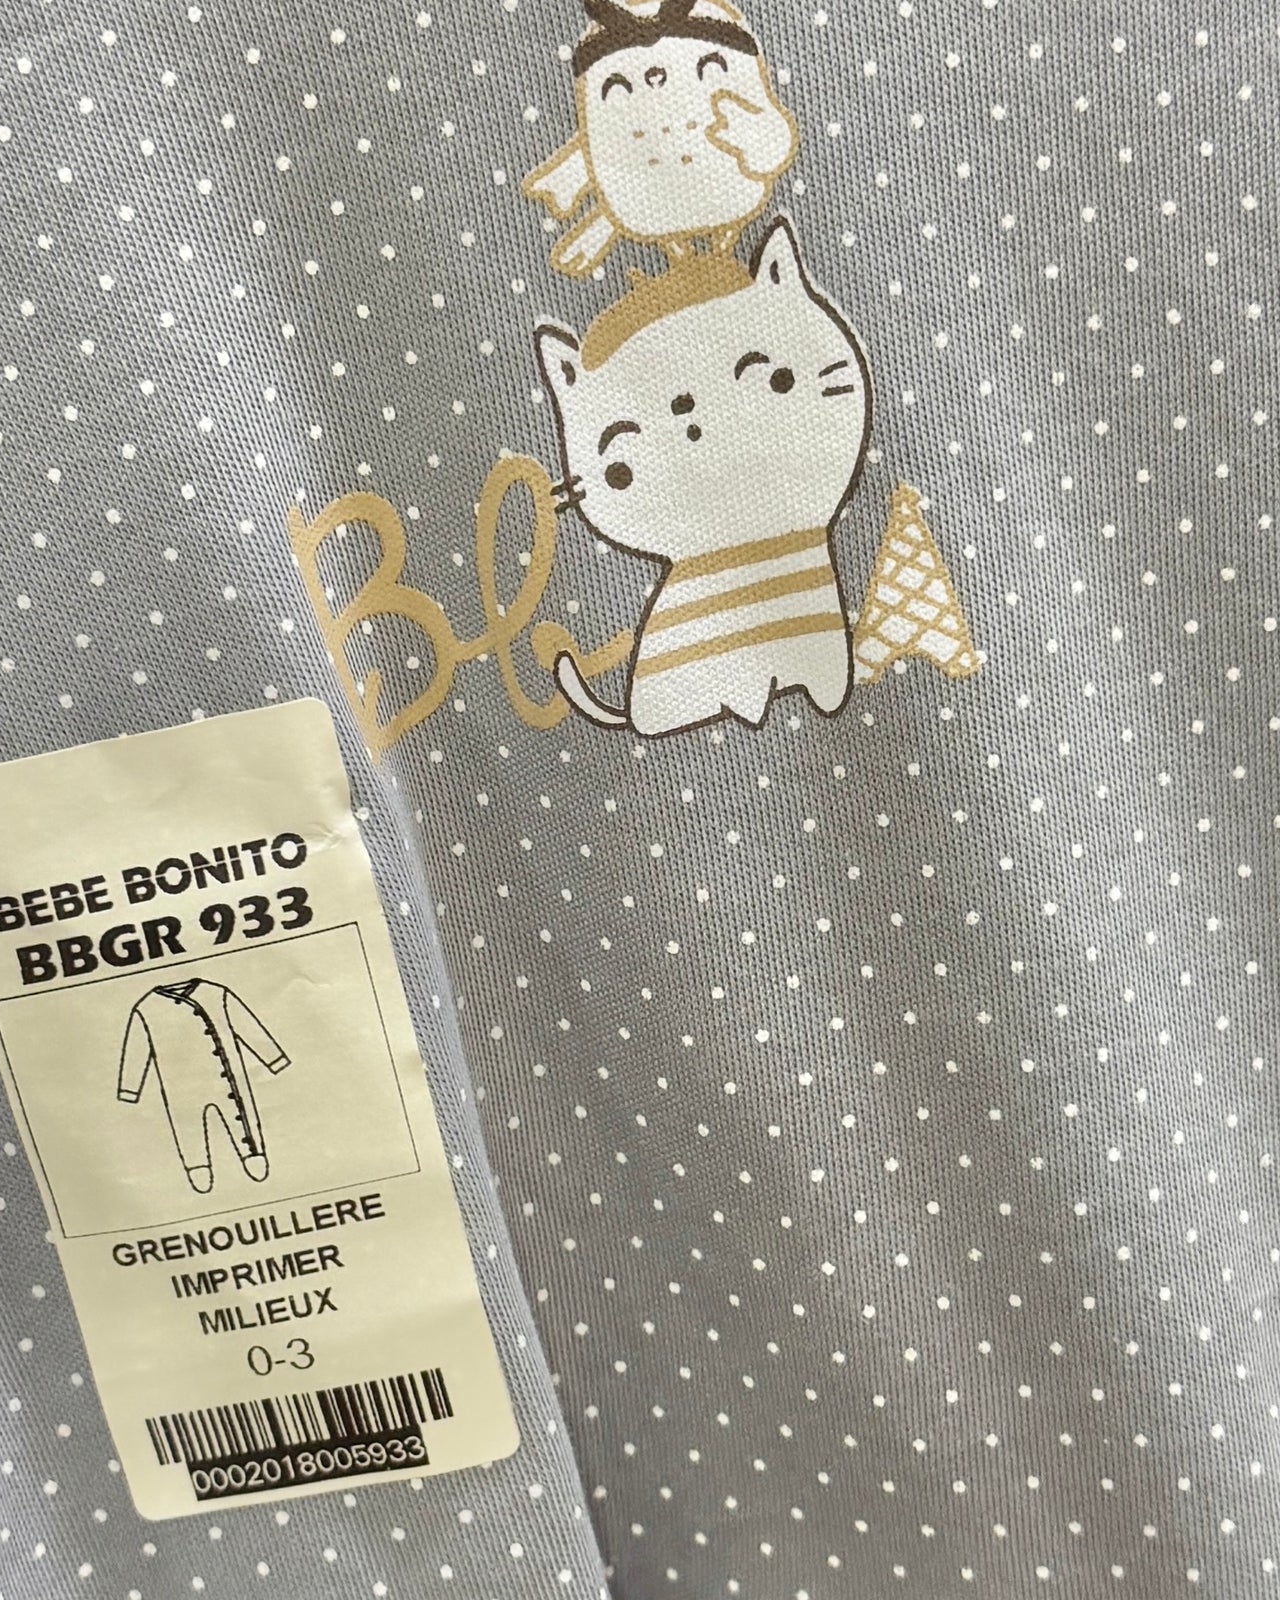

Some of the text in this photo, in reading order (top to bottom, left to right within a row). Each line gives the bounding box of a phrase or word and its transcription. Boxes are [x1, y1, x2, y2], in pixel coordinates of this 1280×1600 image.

[122, 832, 308, 905] BONITO
[16, 886, 314, 986] BBGR 933
[112, 1193, 386, 1267] GRENOUILLERE
[171, 1244, 345, 1299] IMPRIMER
[198, 1286, 338, 1335] MILIEUX
[247, 1337, 316, 1376] 0-3
[191, 1435, 426, 1494] 0002018005933
